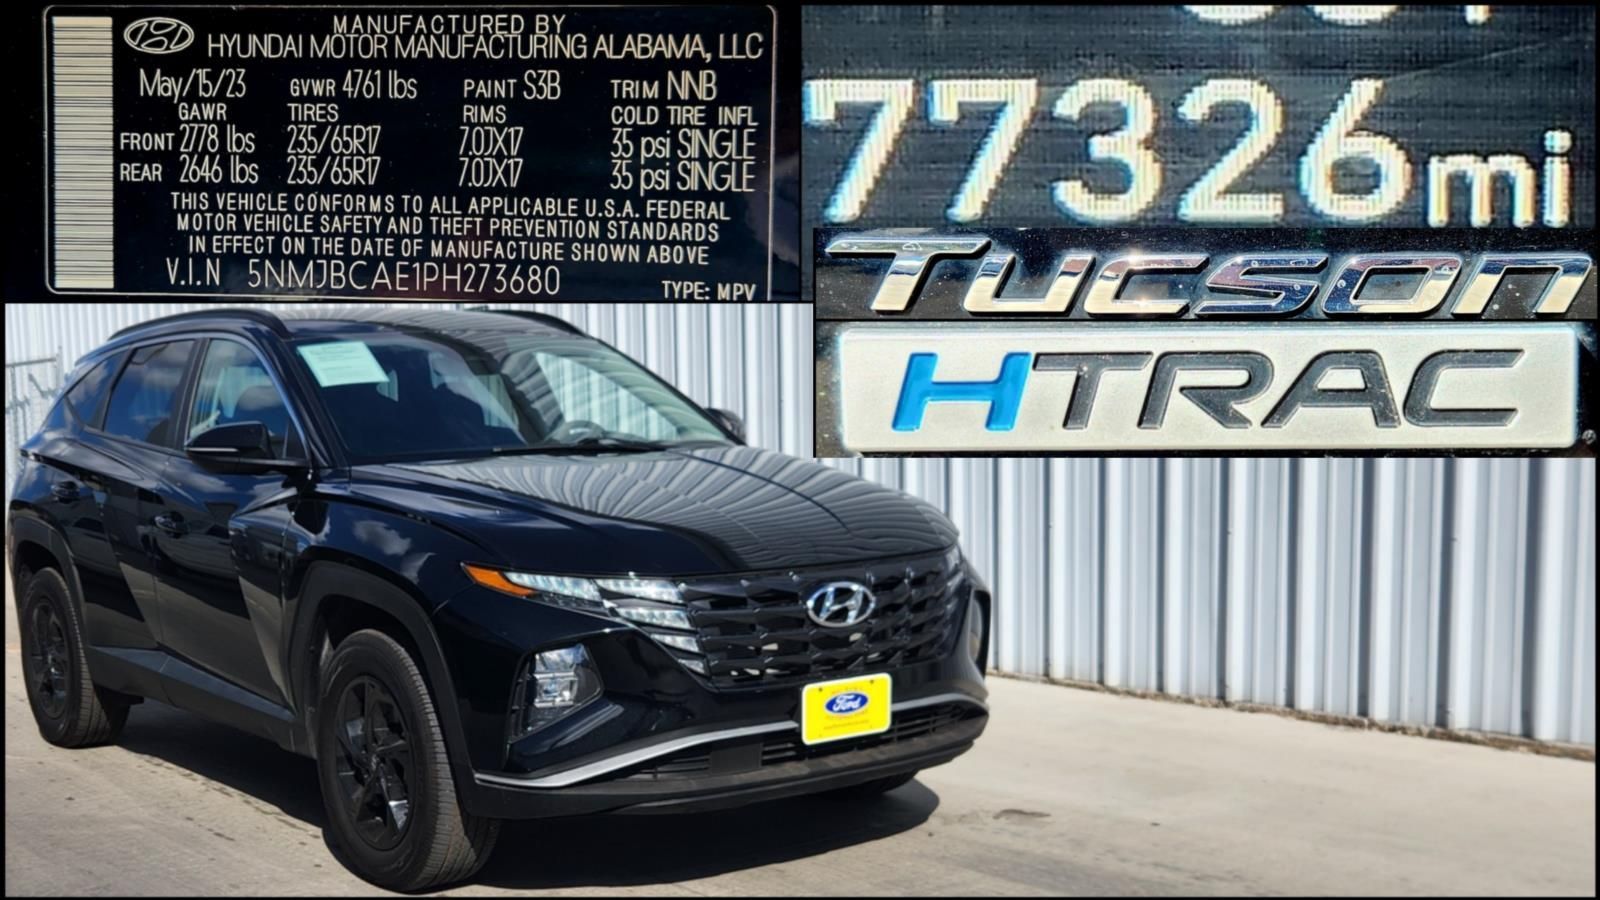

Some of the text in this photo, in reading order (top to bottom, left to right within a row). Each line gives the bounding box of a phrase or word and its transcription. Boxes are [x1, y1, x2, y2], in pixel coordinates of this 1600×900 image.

[334, 15, 565, 35] MANUFACTURED BY
[209, 33, 762, 62] HYUNDAI MOTOR MANUFACTURING ALABAMA, LLC
[140, 69, 246, 103] May/15/23
[291, 69, 417, 99] GVWR 4761 lbs
[464, 70, 560, 99] PAINT S3B
[611, 70, 716, 100] TRIM NNB
[179, 103, 226, 120] GAWR
[287, 103, 338, 122] TIRES
[464, 105, 506, 123] RIMS
[611, 106, 758, 126] COLD TIRE INFL
[121, 124, 255, 153] FRONT 2778 lbs
[288, 125, 381, 154] 235/65R17
[611, 128, 755, 166] 35 psi SINGLE
[120, 154, 258, 184] REAR 2646 lbs
[287, 155, 381, 185] 235/65R17
[610, 160, 755, 196] 35 psi SINGLE
[171, 192, 730, 220] THIS VEHICLE CONFORMS TO ALL APPLICABLE U.S.A. FEDERAL
[178, 213, 719, 242] MOTOR VEHICLE SAFETY AND THEFT PREVENTION STANDARDS
[190, 235, 709, 265] IN EFFECT ON THE DATE OF MANUFACTURE SHOWN ABOVE
[167, 258, 561, 295] V.I.N 5NMJBCAE1PH273680
[662, 281, 756, 301] TYPE: MPV
[892, 350, 1524, 432] HTRAC
[832, 694, 862, 712] Ford
